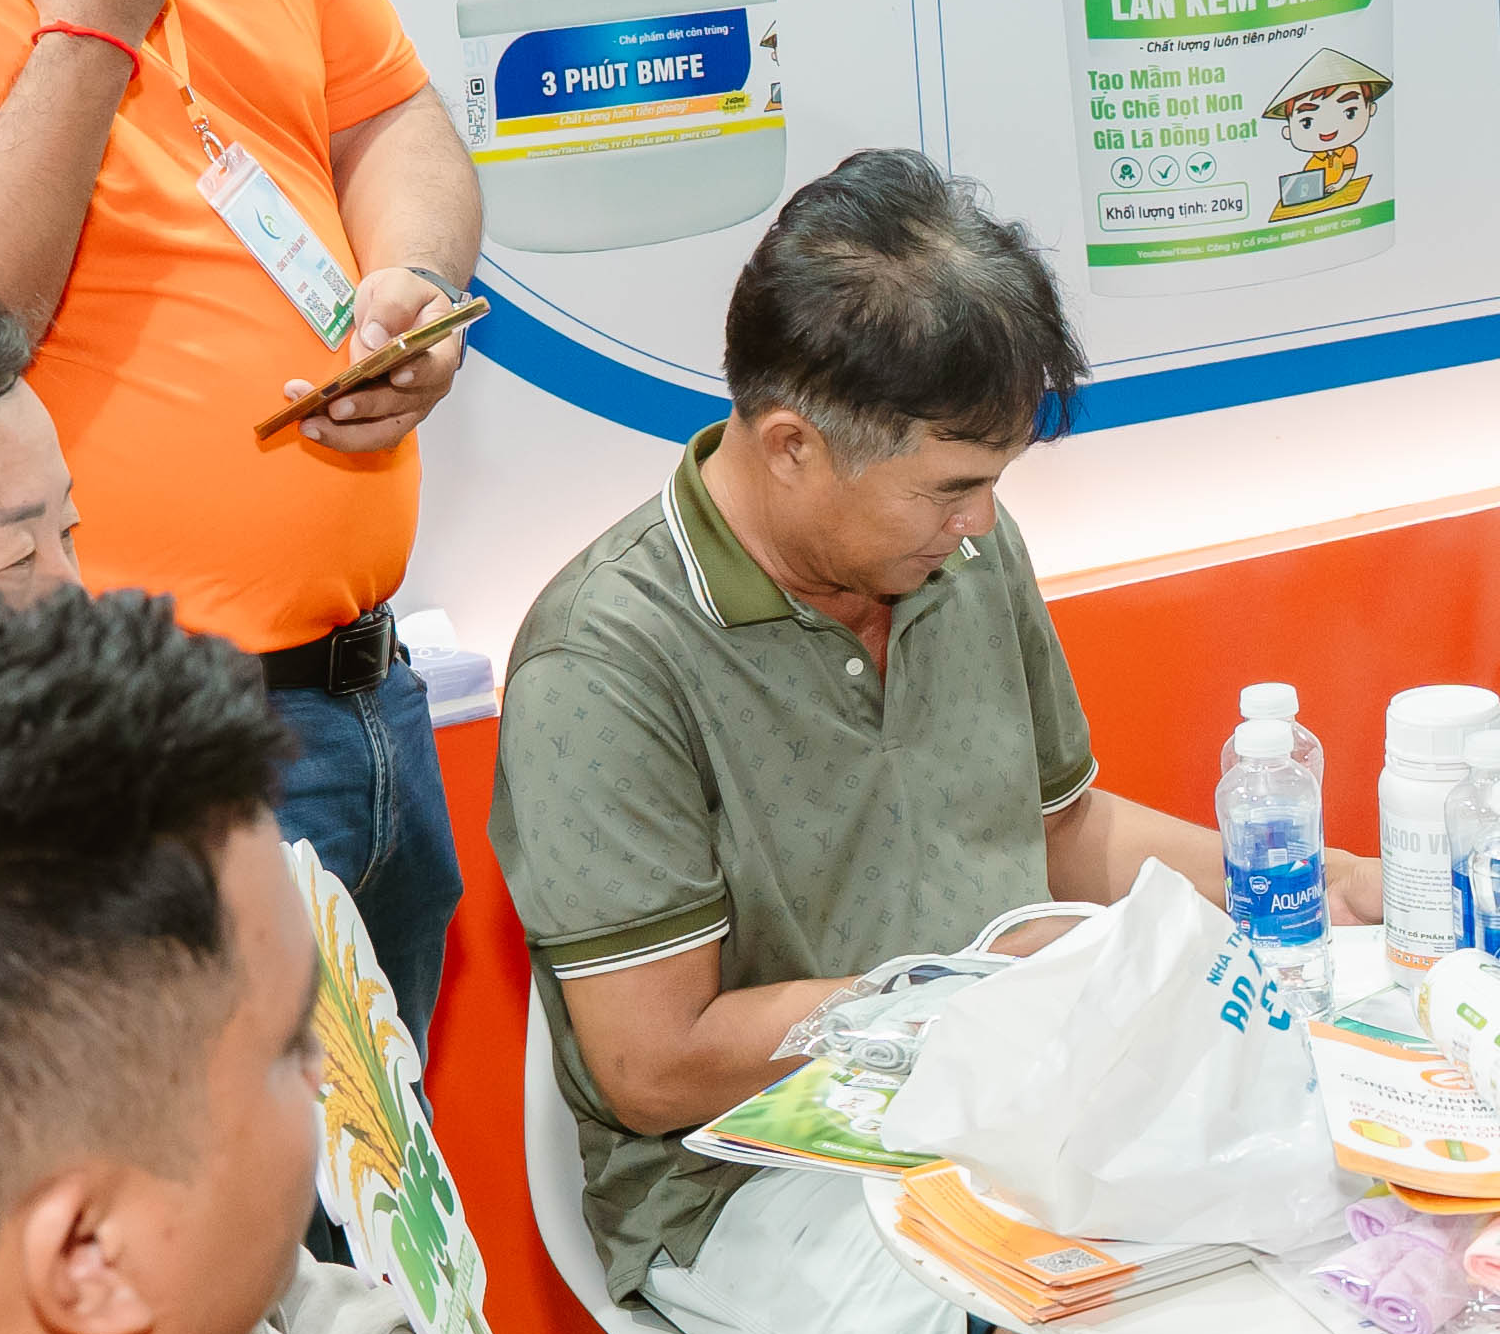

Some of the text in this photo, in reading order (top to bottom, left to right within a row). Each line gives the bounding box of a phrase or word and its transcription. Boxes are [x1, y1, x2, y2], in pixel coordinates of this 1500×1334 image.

[541, 53, 704, 96] 3 PHÚT BMFE
[1106, 199, 1242, 221] Khối lượng tịnh: 20kg
